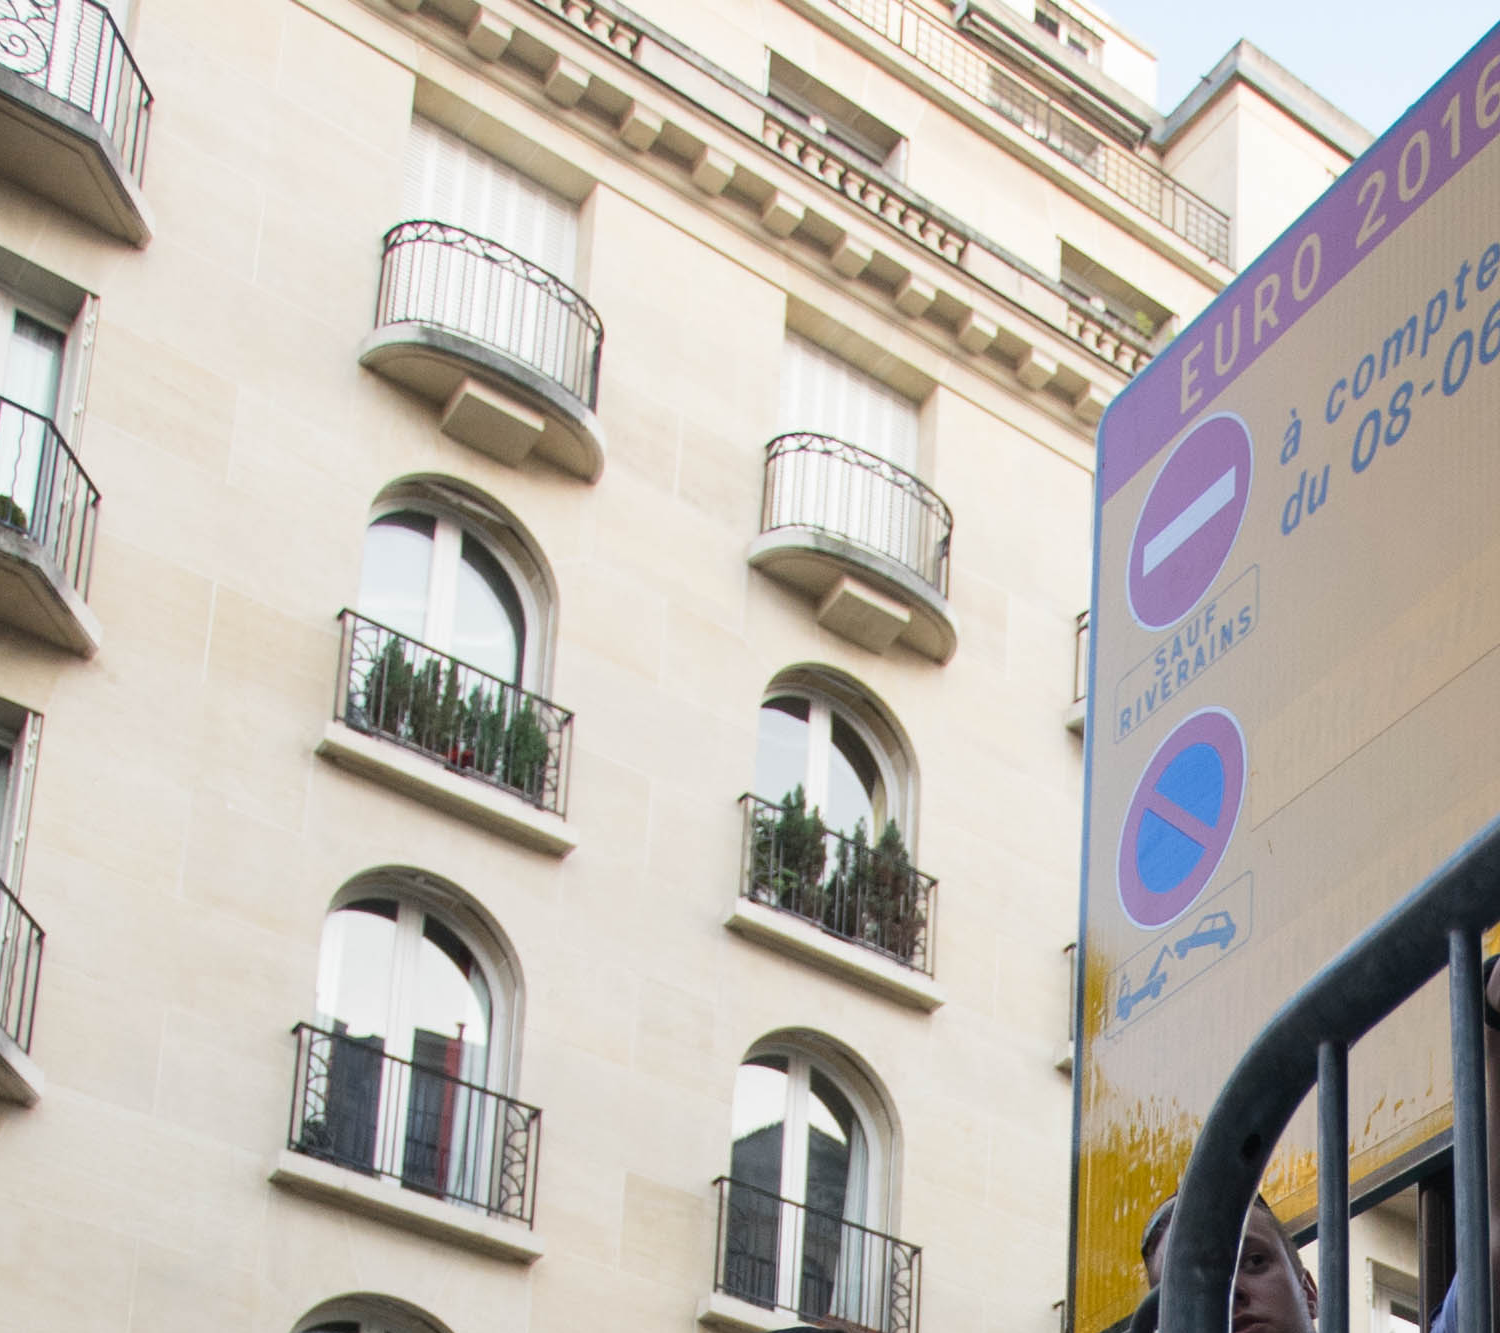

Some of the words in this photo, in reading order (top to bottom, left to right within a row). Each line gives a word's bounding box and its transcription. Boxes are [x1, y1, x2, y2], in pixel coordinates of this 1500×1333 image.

[1180, 232, 1322, 415] EURO
[1280, 408, 1303, 466] à
[1281, 464, 1331, 537] du
[1119, 605, 1251, 737] RIVERAINS
[1155, 603, 1216, 677] SAUF
